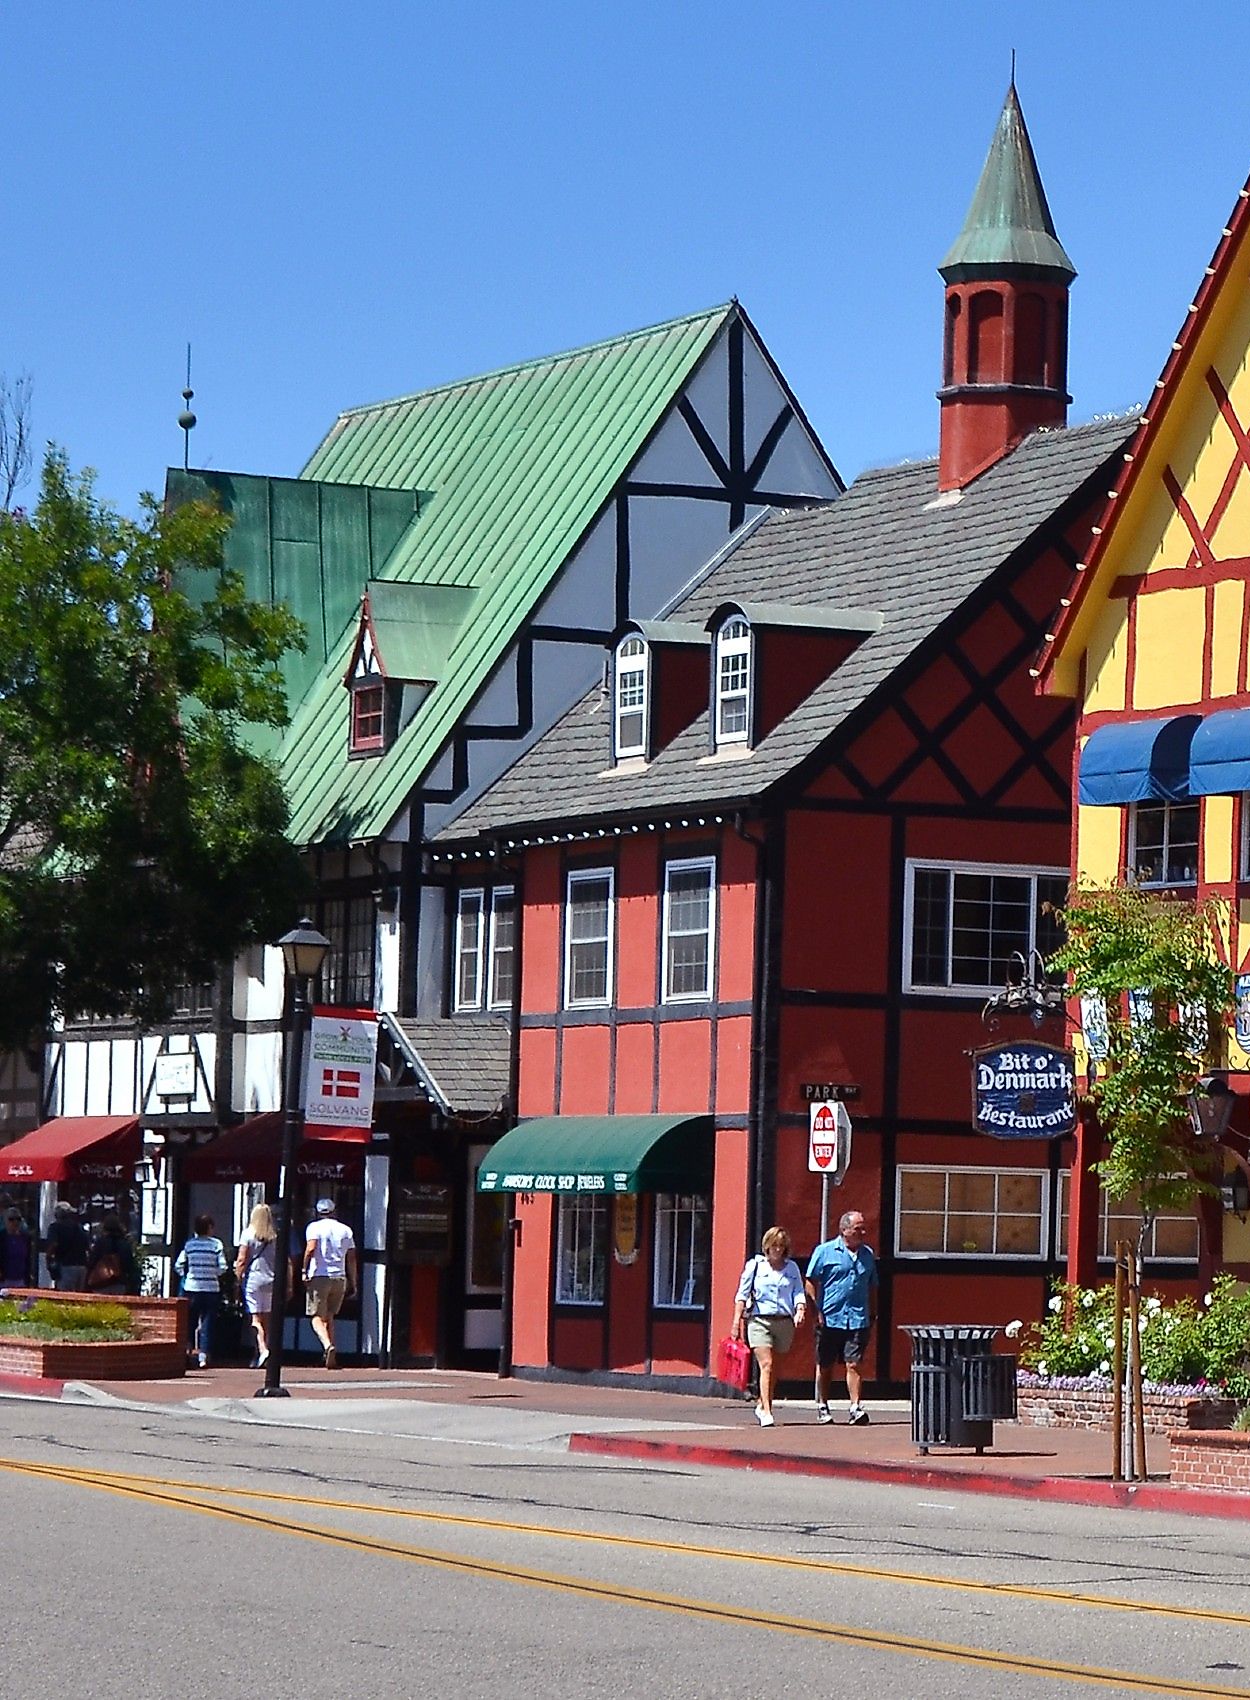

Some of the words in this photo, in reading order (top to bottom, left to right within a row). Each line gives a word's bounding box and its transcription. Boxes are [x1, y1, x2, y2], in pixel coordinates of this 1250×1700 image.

[314, 1042, 374, 1054] COMMUNITY
[999, 1053, 1030, 1070] Bit
[1034, 1053, 1053, 1070] o'
[977, 1063, 1073, 1095] Denmark
[806, 1085, 839, 1099] PARK
[309, 1102, 369, 1116] SOLVANG
[977, 1101, 1074, 1129] Restaurant
[815, 1117, 824, 1130] DO
[824, 1117, 834, 1130] NOT
[815, 1145, 832, 1158] ENTER
[535, 1175, 556, 1189] CLOCK
[558, 1176, 575, 1189] SHOP
